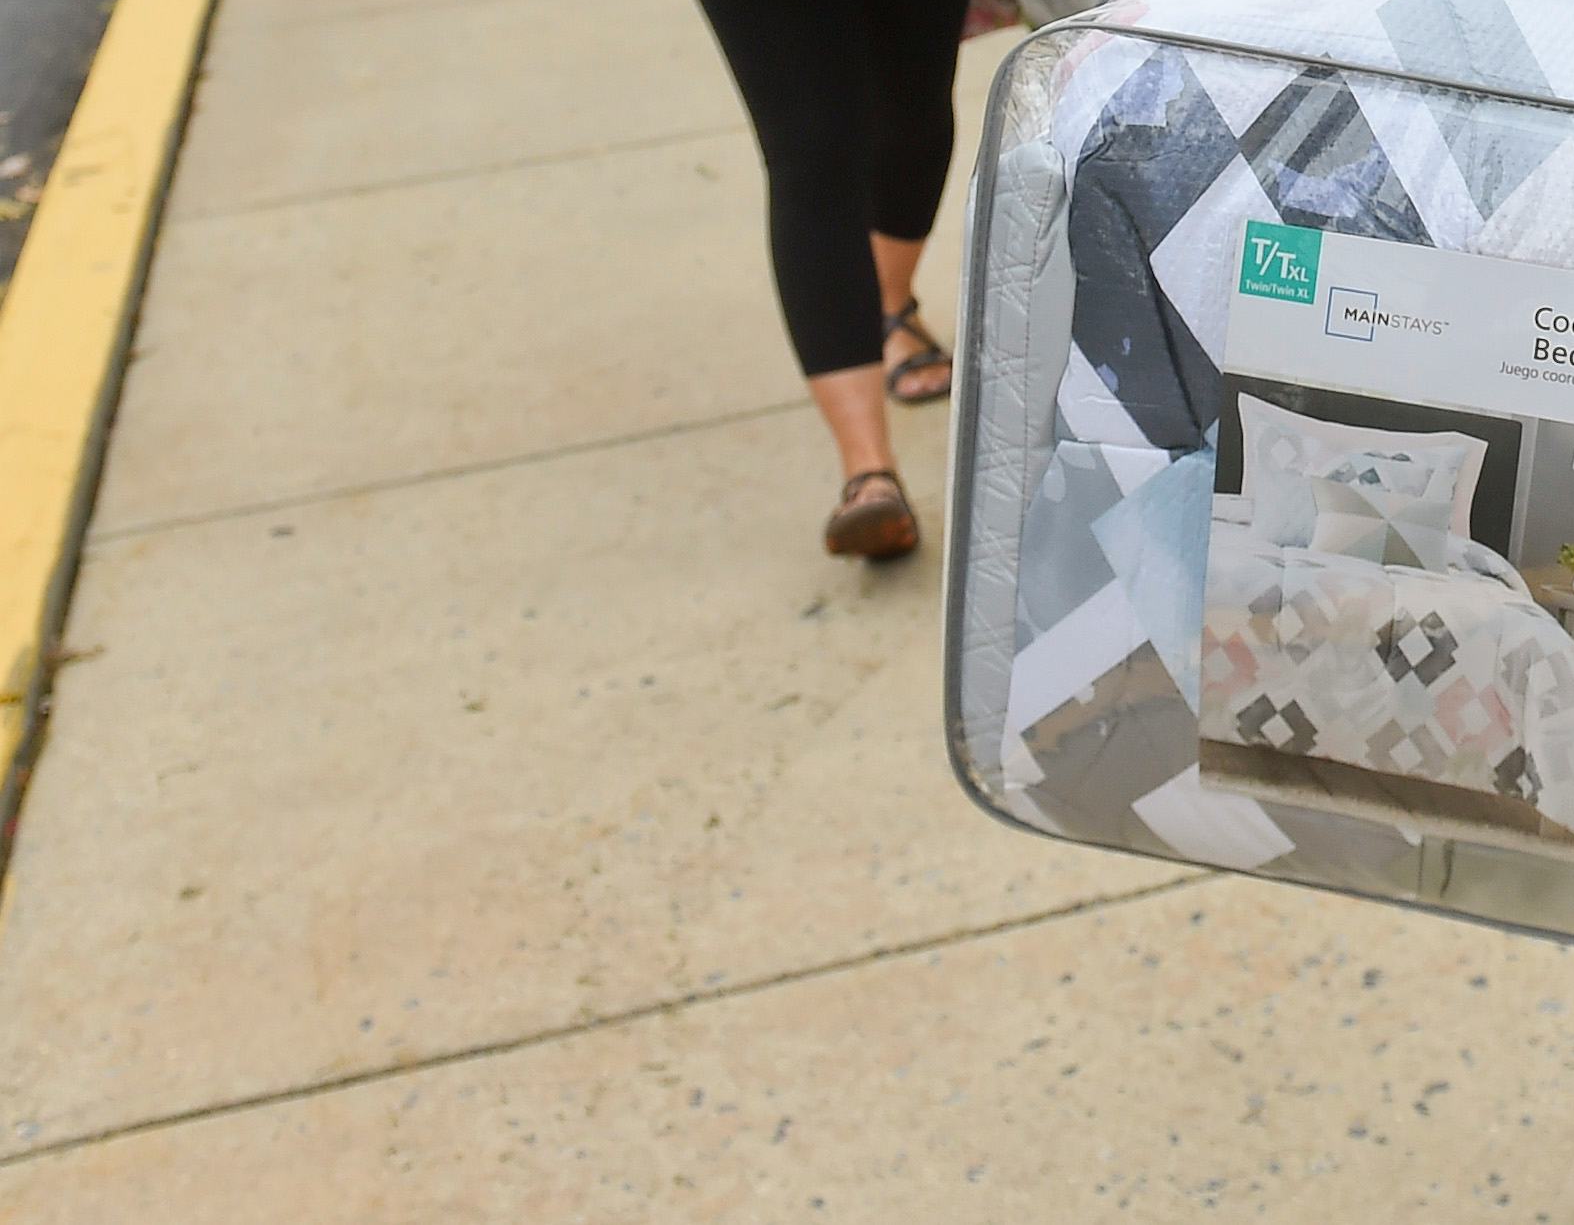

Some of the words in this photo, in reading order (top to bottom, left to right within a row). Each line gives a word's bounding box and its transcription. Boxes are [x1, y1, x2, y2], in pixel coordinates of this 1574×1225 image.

[1245, 279, 1295, 297] Twin/Twin
[1297, 287, 1311, 300] XL
[1500, 361, 1539, 380] Juego
